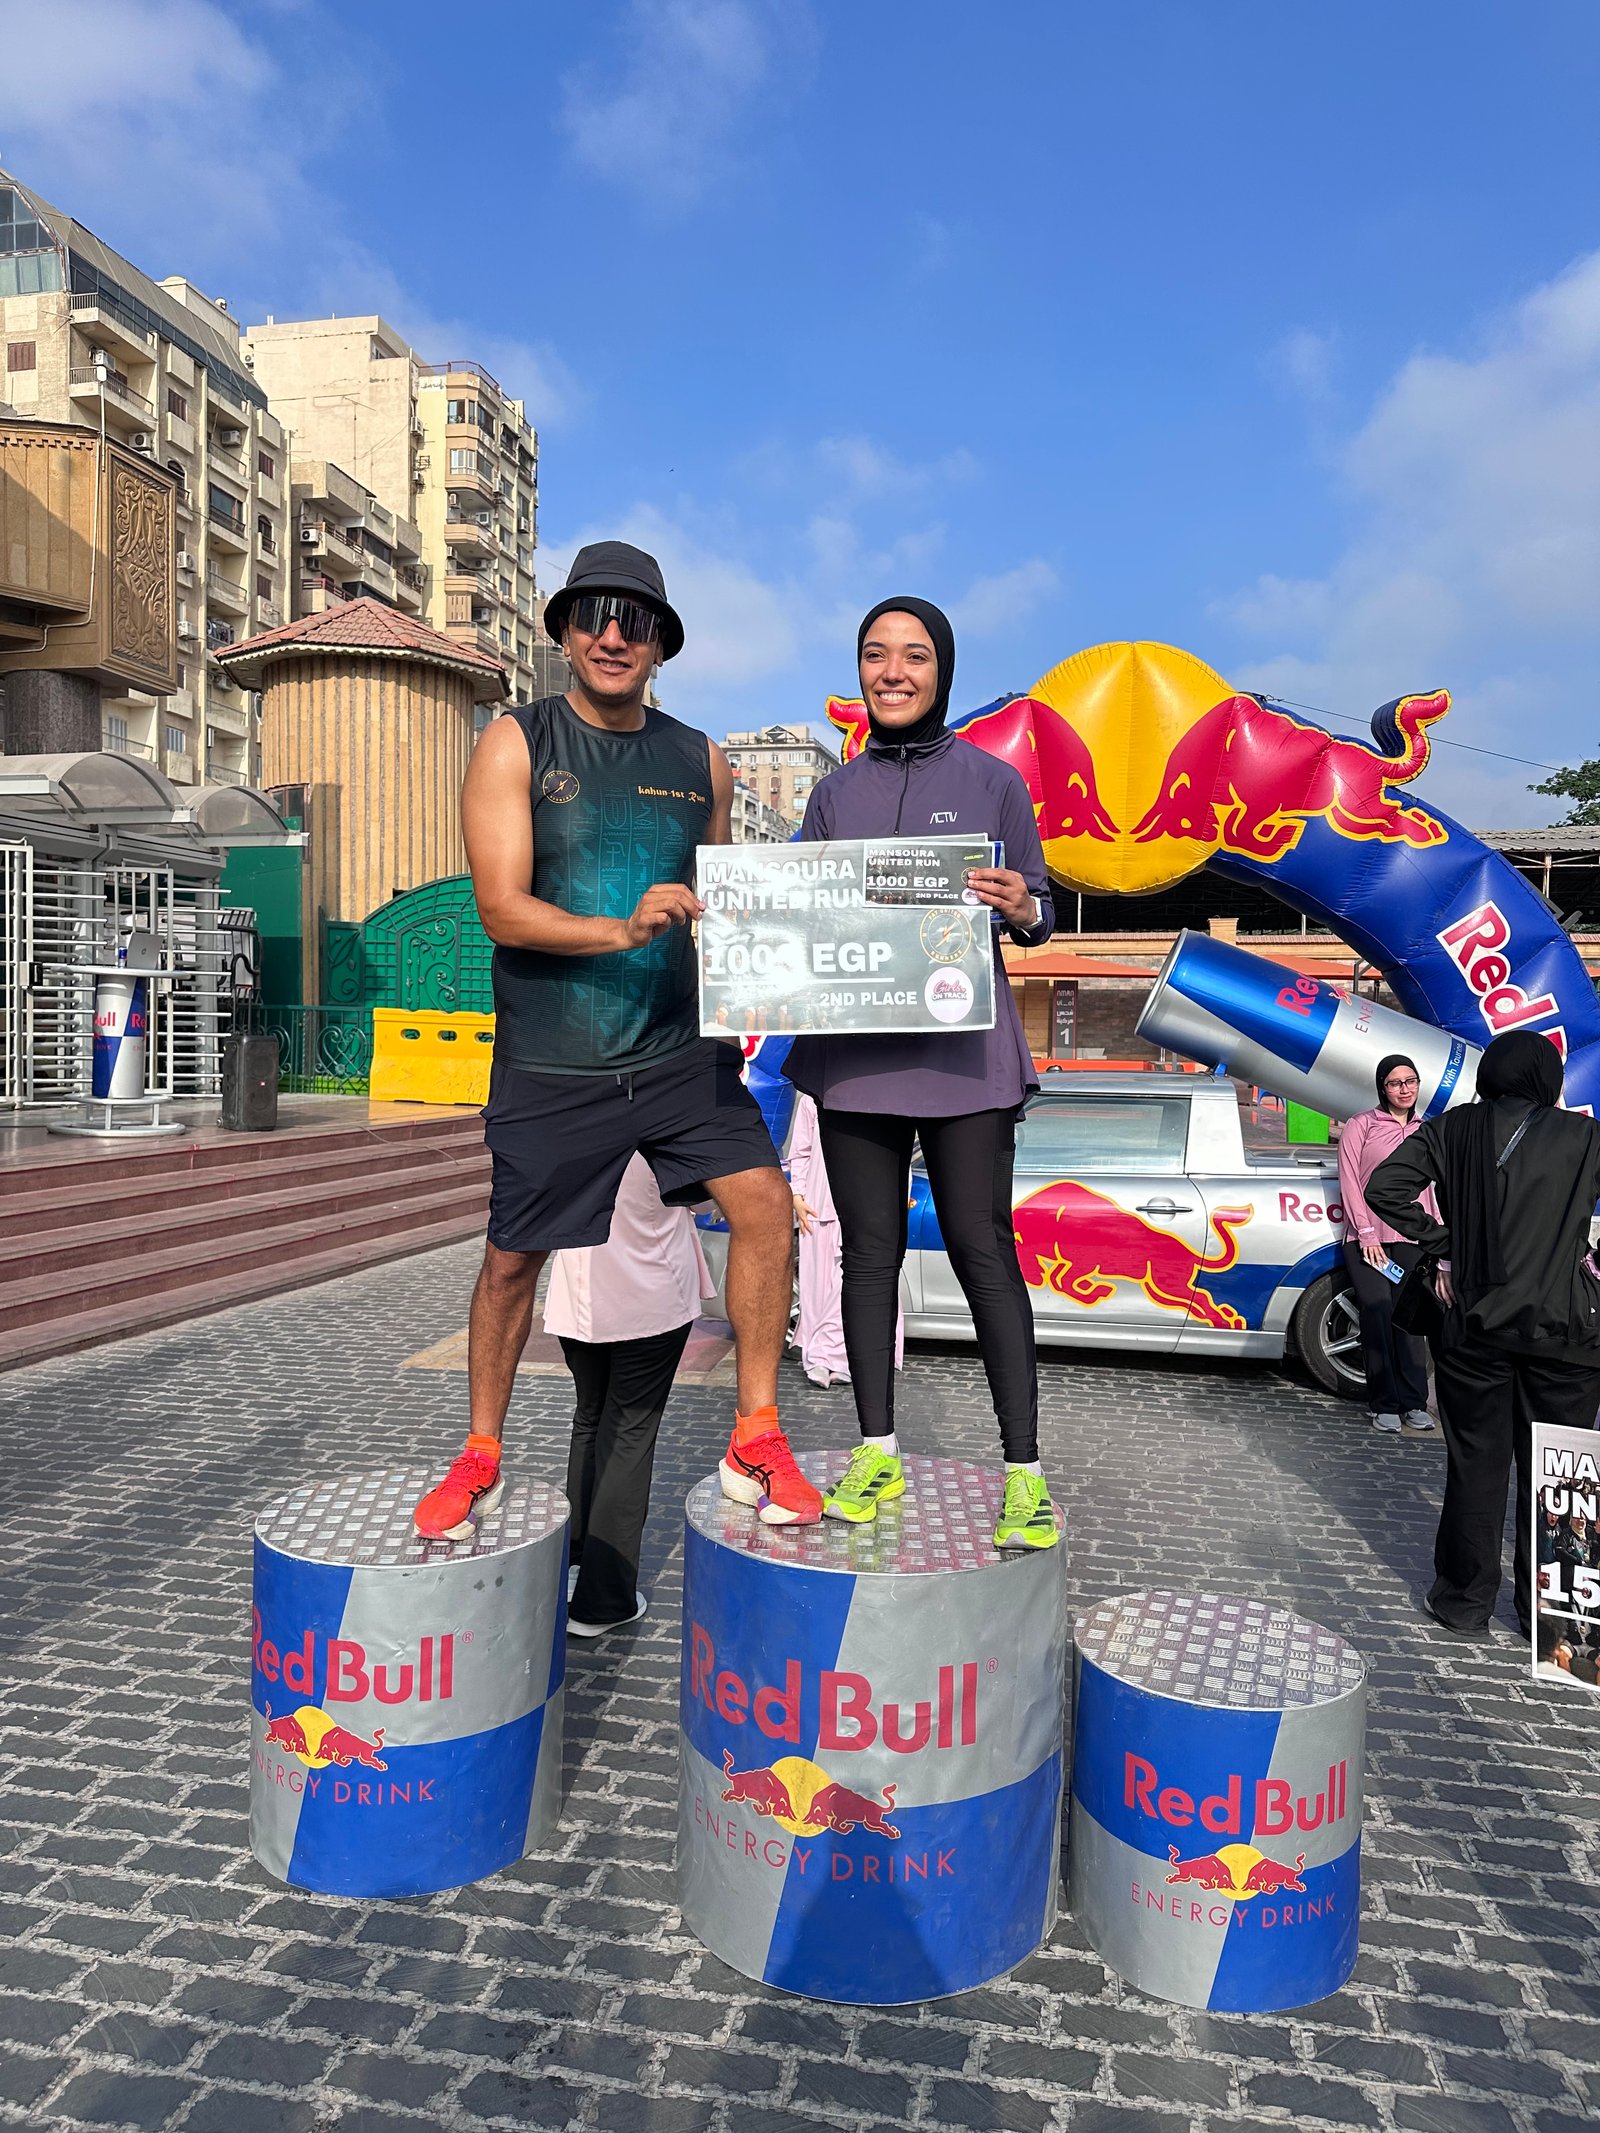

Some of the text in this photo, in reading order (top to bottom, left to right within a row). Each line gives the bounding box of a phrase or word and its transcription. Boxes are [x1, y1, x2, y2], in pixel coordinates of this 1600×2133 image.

[868, 858, 941, 867] UNITED RUN
[869, 849, 935, 858] MANSOURA
[705, 858, 857, 883] MANSOURA
[866, 876, 949, 888] 1000 EGP
[706, 888, 865, 911] UNITED RUN
[812, 942, 892, 973] EGP
[1441, 903, 1555, 1032] Red
[819, 991, 918, 1007] 2ND PLACE
[932, 990, 967, 1001] ON TRACK
[1275, 973, 1319, 1017] Re
[1060, 1028, 1070, 1045] 1
[1441, 1064, 1458, 1088] With
[252, 1604, 454, 1704] Red Bull
[691, 1622, 978, 1754] Red Bull
[334, 1779, 435, 1805] DRINK
[1124, 1751, 1347, 1836] Red Bull
[694, 1796, 957, 1883] ENERGY DRINK
[1131, 1882, 1335, 1928] ENERGY DRINK
